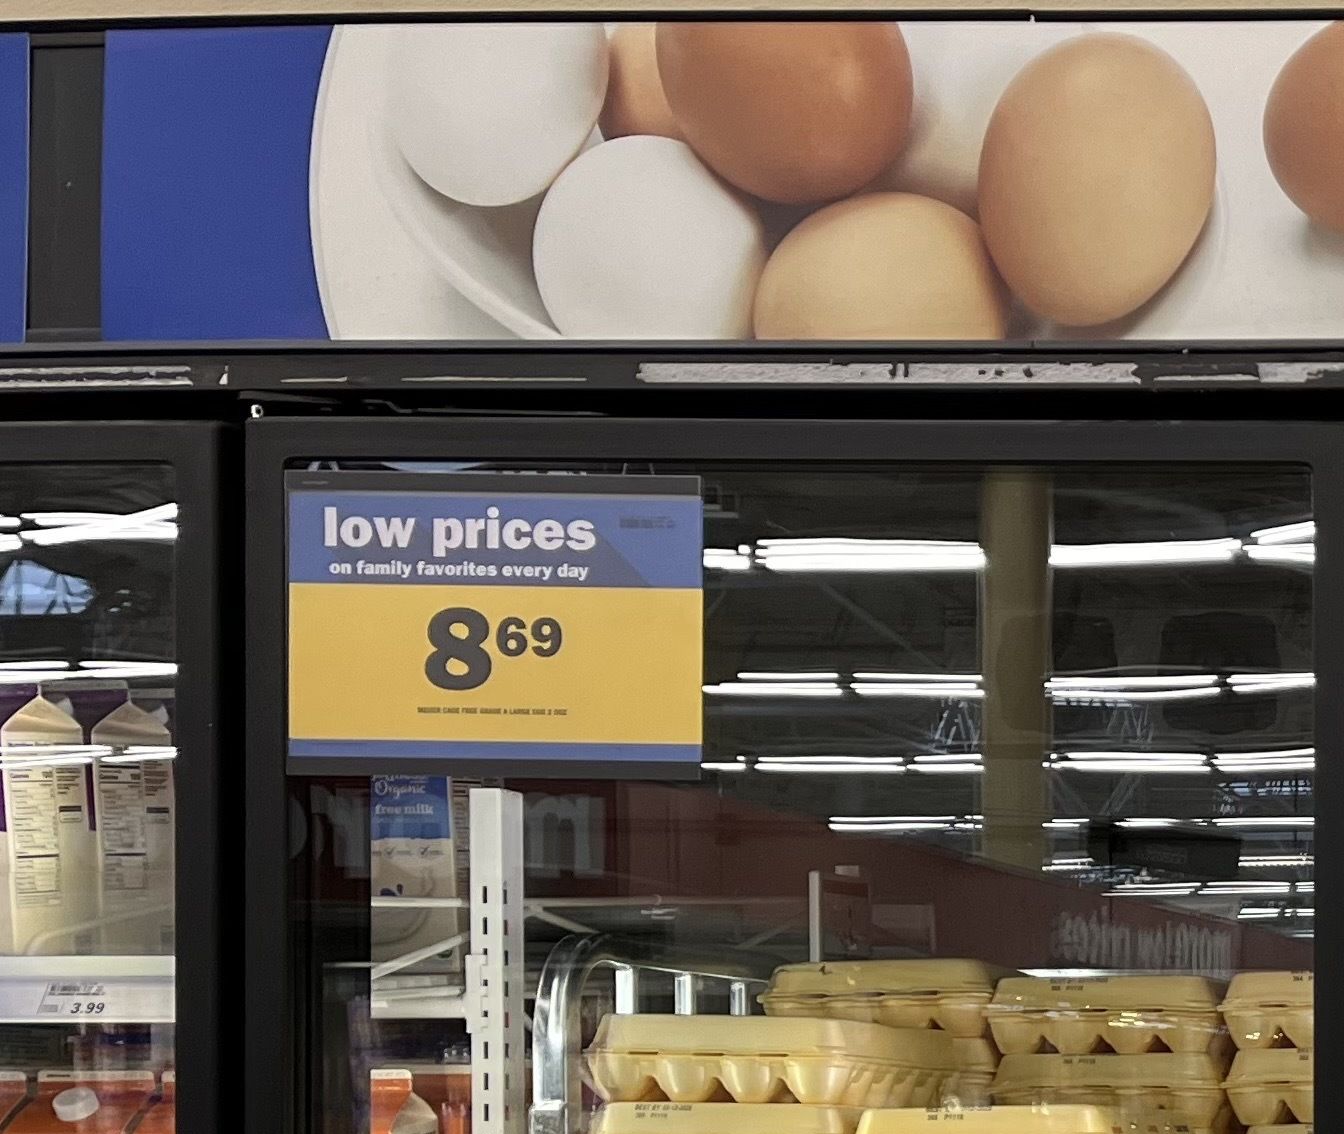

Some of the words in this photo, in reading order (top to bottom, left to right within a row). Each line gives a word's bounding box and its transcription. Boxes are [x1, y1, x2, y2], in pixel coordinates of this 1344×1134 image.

[324, 506, 416, 548] low
[432, 506, 596, 558] prices
[328, 562, 352, 574] on
[356, 560, 412, 578] family
[416, 560, 498, 578] favorites
[500, 564, 552, 580] every
[556, 564, 588, 582] day
[424, 606, 492, 692] 8
[496, 616, 564, 658] 69
[374, 780, 426, 800] Organic
[404, 804, 434, 814] milk
[70, 1002, 106, 1014] 3.99
